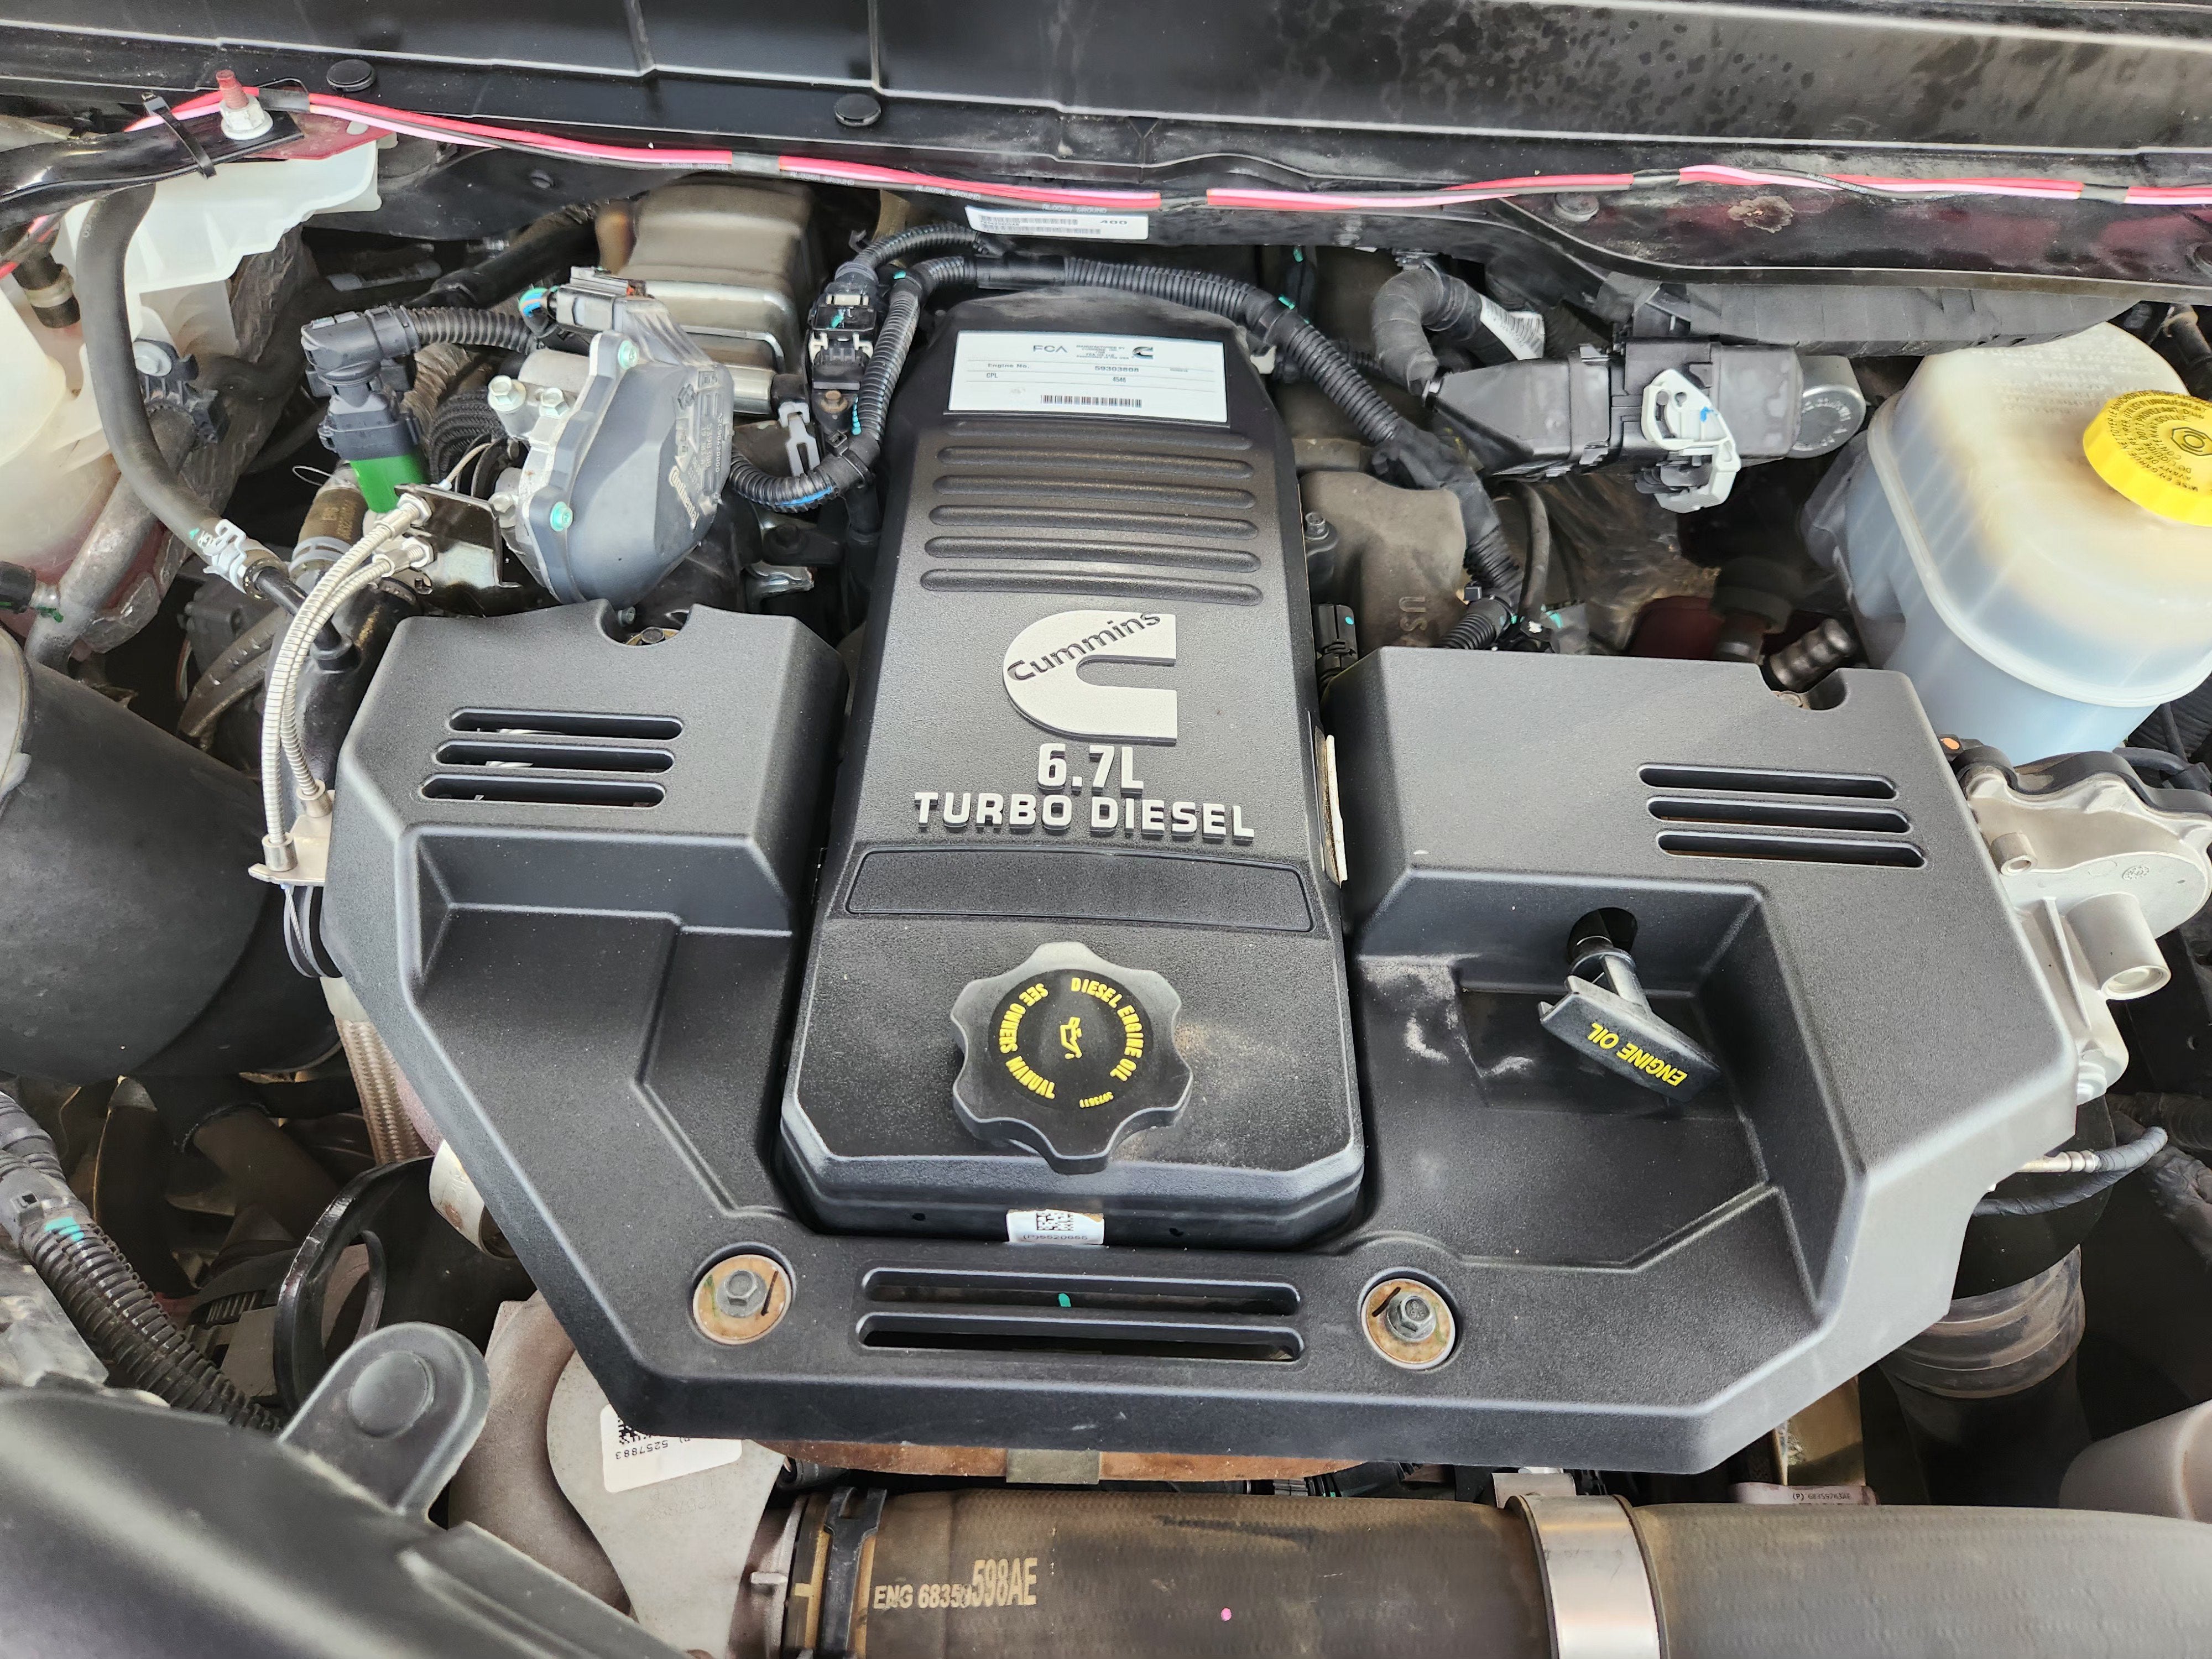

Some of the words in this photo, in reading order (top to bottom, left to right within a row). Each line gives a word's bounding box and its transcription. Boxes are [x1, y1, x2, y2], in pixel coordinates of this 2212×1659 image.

[950, 189, 982, 200] GROUND
[1839, 181, 1867, 194] GROUND
[1077, 206, 1108, 214] GROUND
[1032, 345, 1068, 353] FCA
[669, 465, 700, 523] Continental
[1006, 611, 1162, 681] Cummins
[1037, 743, 1144, 795] 6.7L
[914, 791, 1073, 828] TURBO
[1091, 795, 1255, 843] DIESEL
[1019, 983, 1049, 1007] SEE
[1071, 977, 1123, 1008] DIESEL
[1117, 1004, 1144, 1058] ENGINE
[1587, 1022, 1620, 1050] OIL
[1110, 1058, 1137, 1082] OIL
[1616, 1041, 1688, 1087] ENGINE
[1005, 1056, 1055, 1099] MANUAL
[615, 1440, 669, 1459] 5257883
[1792, 1493, 1804, 1501] (P)
[873, 1584, 914, 1609] ENG
